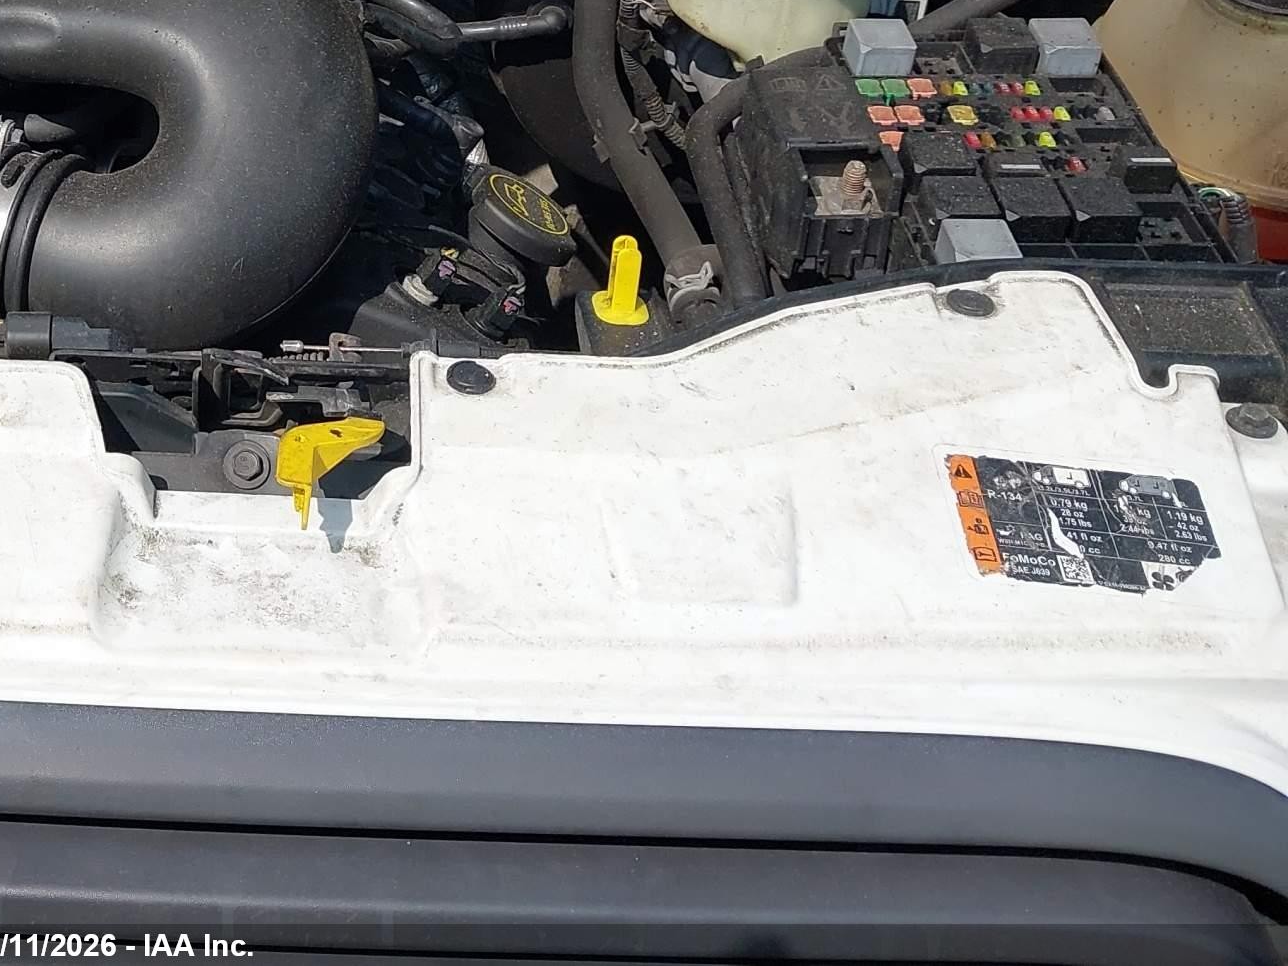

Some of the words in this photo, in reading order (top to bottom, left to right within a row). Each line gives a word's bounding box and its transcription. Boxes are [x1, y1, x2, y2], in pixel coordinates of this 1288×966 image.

[1073, 499, 1088, 512] kg
[1073, 511, 1085, 519] oz
[1189, 513, 1204, 525] kg
[1077, 518, 1093, 528] lbs
[1176, 521, 1188, 531] 42
[1188, 524, 1201, 533] oz
[1089, 535, 1103, 543] oz
[1192, 532, 1209, 542] lbs
[1158, 553, 1177, 564] 280
[1178, 557, 1191, 565] cc
